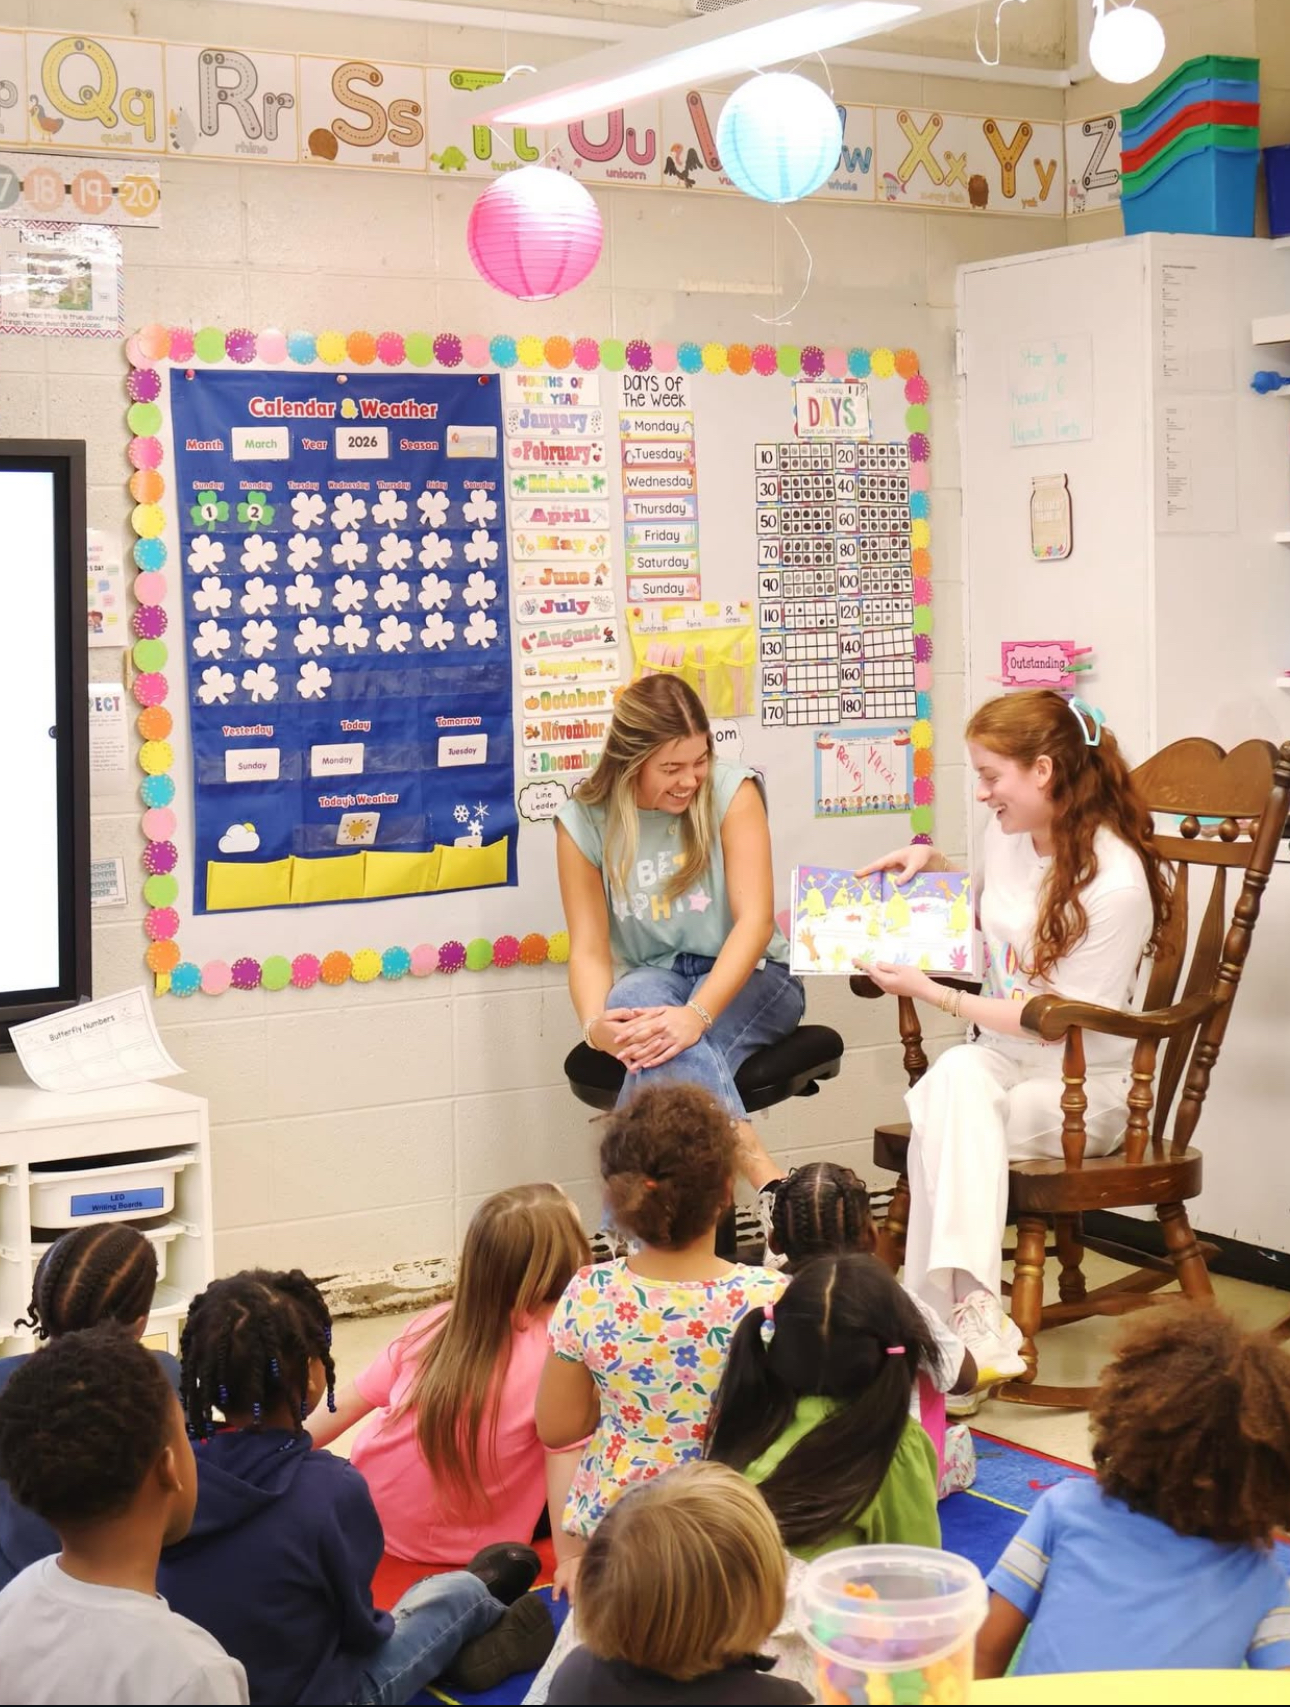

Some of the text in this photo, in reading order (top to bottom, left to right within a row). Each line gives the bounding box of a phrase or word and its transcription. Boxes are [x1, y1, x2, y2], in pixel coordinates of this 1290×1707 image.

[235, 142, 269, 155] rhino
[606, 167, 647, 180] unicorn
[33, 174, 57, 202] 18
[79, 178, 104, 207] 19
[123, 183, 157, 209] 20
[517, 375, 584, 389] MONTHS OF
[550, 393, 579, 406] YEAR
[249, 396, 337, 419] Calendar
[360, 399, 438, 420] Weather
[807, 396, 857, 427] DAYS
[519, 409, 588, 433] January
[634, 419, 680, 434] Monday
[186, 438, 224, 451] Month
[244, 438, 278, 450] March
[302, 438, 328, 451] Year
[347, 436, 379, 449] 2026
[399, 438, 439, 451] Season
[522, 440, 591, 465] February
[634, 448, 682, 462] Tuesday
[761, 450, 773, 464] 10
[837, 449, 854, 464] 20
[192, 480, 225, 491] Sunday
[239, 480, 273, 491] Monday
[287, 480, 320, 491] Tuesday
[327, 480, 370, 490] Wednesday
[376, 480, 411, 491] Thursday
[425, 480, 449, 491] Friday
[463, 480, 497, 491] Saturday
[528, 473, 591, 493] March
[626, 475, 694, 489] Wednesday
[837, 479, 855, 493] 40
[759, 482, 777, 497] 30
[205, 506, 213, 519] 1
[250, 505, 260, 518] 2
[633, 503, 687, 516] Thursday
[529, 508, 591, 526] April
[760, 514, 777, 528] 50
[838, 512, 855, 527] 60
[644, 529, 681, 543] Friday
[536, 536, 587, 554] May
[762, 545, 778, 559] 70
[839, 543, 856, 557] 80
[636, 556, 690, 570] Saturday
[539, 568, 590, 586] June
[839, 575, 859, 589] 100
[642, 583, 686, 597] Sunday
[762, 578, 779, 593] 90
[539, 598, 591, 616] July
[840, 605, 861, 619] 120
[763, 609, 780, 623] 110
[638, 624, 668, 633] hundreds
[686, 619, 702, 628] tens
[536, 625, 603, 648] August
[762, 641, 783, 656] 130
[840, 639, 862, 653] 140
[1010, 656, 1066, 672] Outstanding
[764, 673, 783, 687] 150
[840, 667, 861, 681] 160
[539, 688, 607, 711] October
[842, 699, 862, 713] 180
[763, 705, 784, 720] 170
[340, 719, 372, 732] Today
[435, 716, 482, 728] Tomorrow
[223, 724, 275, 737] Yesterday
[540, 719, 606, 743] November
[448, 746, 478, 756] Tuesday
[238, 760, 268, 771] Sunday
[321, 754, 354, 766] Monday
[540, 749, 601, 773] Decembe
[318, 792, 399, 808] Today's Weather
[535, 791, 552, 800] Line
[530, 801, 558, 811] Leader
[83, 1015, 116, 1031] Numbers
[110, 1193, 125, 1202] LED
[92, 1201, 143, 1211] Writing Boards
